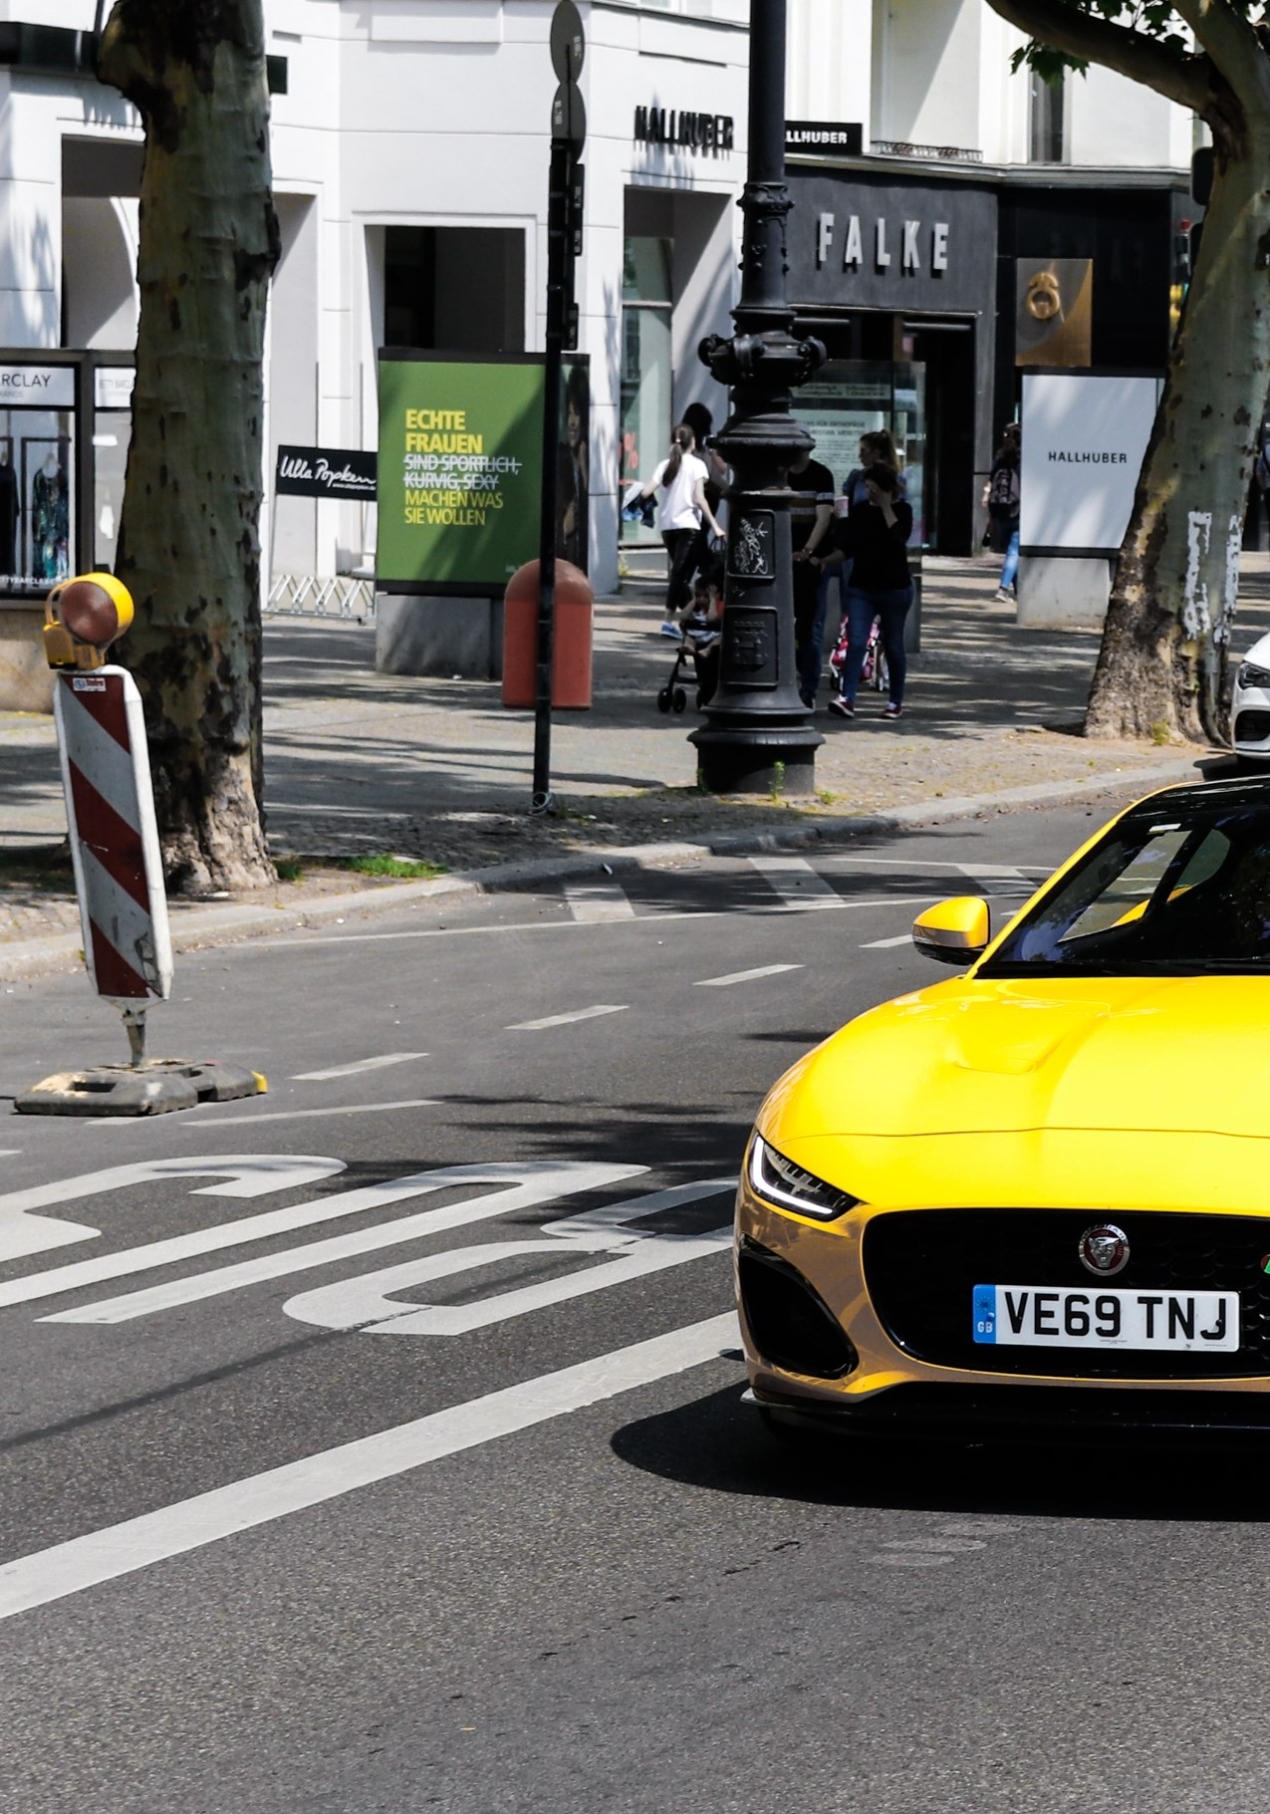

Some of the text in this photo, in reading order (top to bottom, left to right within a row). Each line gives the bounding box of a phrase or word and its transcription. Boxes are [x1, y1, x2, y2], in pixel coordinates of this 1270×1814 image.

[634, 105, 734, 150] HALLHUBER
[785, 130, 848, 144] LLHUBER
[818, 212, 950, 271] FALKE
[405, 409, 466, 430] ECHTE
[405, 432, 483, 454] FRAUEN
[404, 454, 440, 471] SIND
[1048, 451, 1128, 464] HALLHUBER
[280, 455, 377, 488] Ulla Popken
[404, 472, 499, 491] KURVIG, SEXY
[405, 490, 504, 509] MACHEN WAS
[404, 507, 486, 526] SIE WOLLEN
[1004, 1291, 1227, 1341] VE69 TNJ
[977, 1321, 993, 1334] GB
